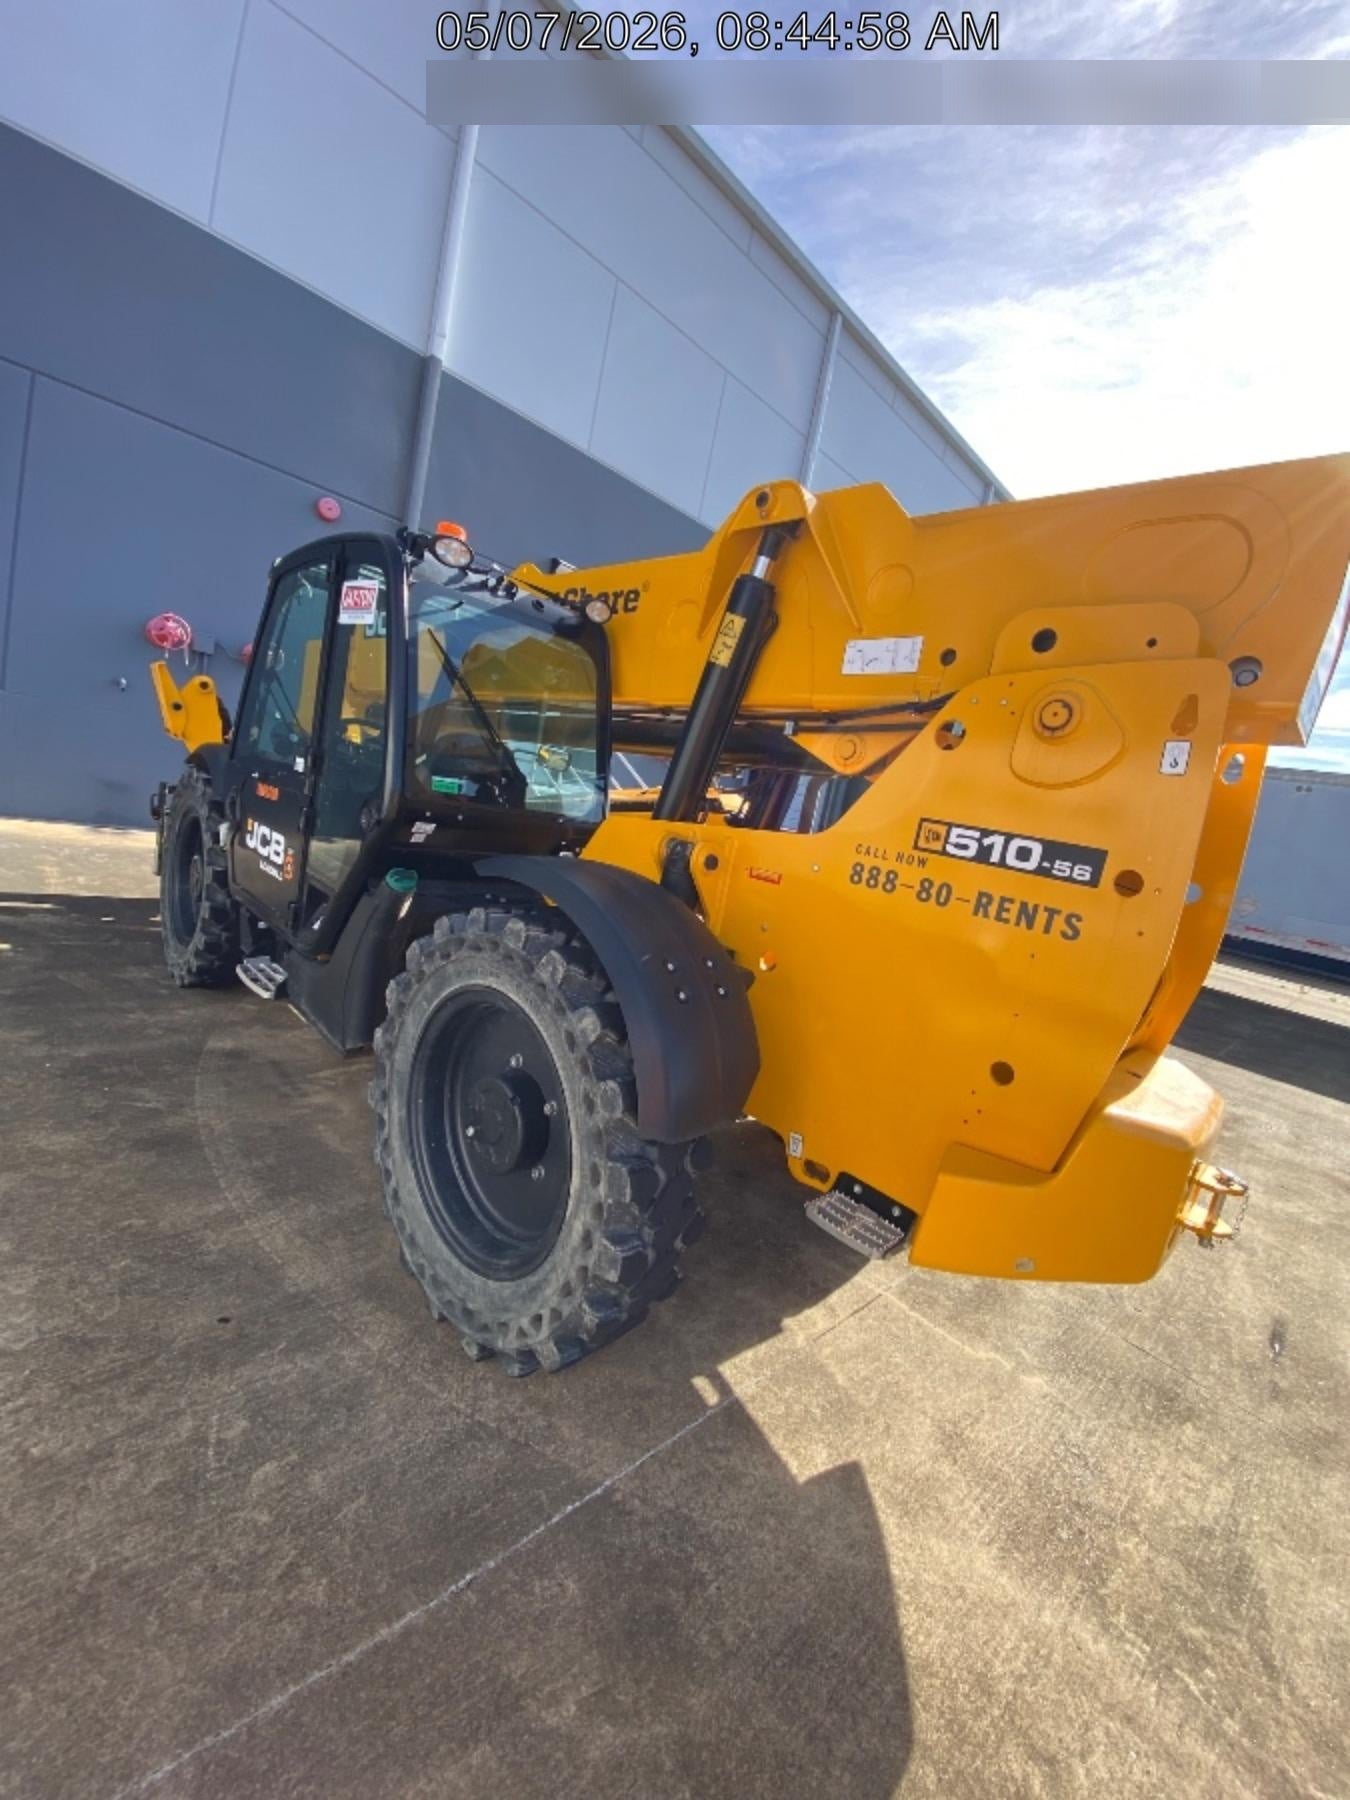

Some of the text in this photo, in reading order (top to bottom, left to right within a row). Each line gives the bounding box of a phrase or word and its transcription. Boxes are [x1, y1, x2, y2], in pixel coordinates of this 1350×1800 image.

[246, 818, 285, 866] JCB
[855, 843, 929, 868] CALL NOW
[945, 826, 1093, 882] 510-56
[849, 862, 1083, 941] 888-80-RENTS
